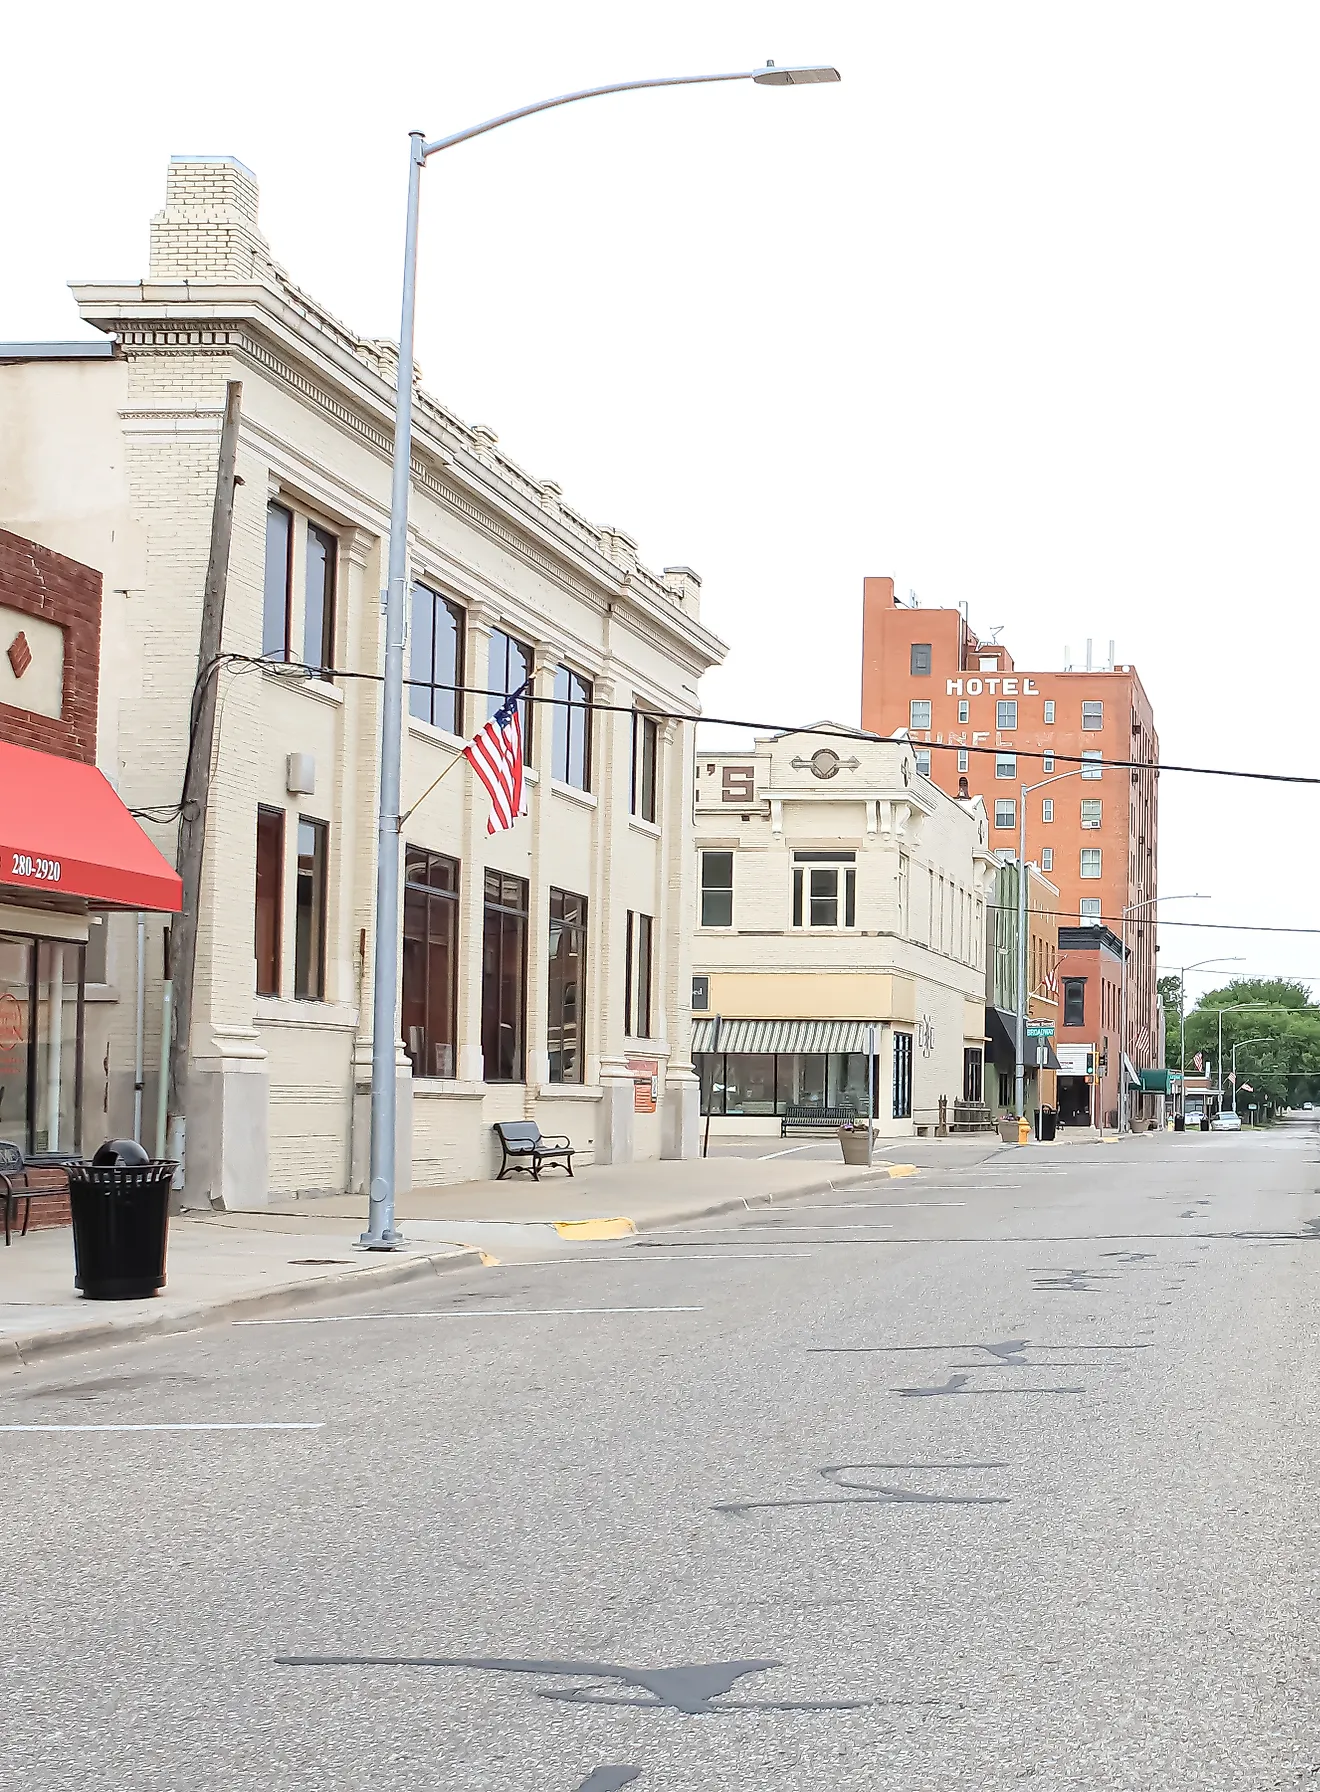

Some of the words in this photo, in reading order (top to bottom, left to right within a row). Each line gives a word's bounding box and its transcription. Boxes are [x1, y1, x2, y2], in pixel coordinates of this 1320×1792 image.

[946, 678, 1040, 696] HOTEL
[11, 853, 61, 882] 280-2920
[1026, 1028, 1055, 1037] BROADWAY
